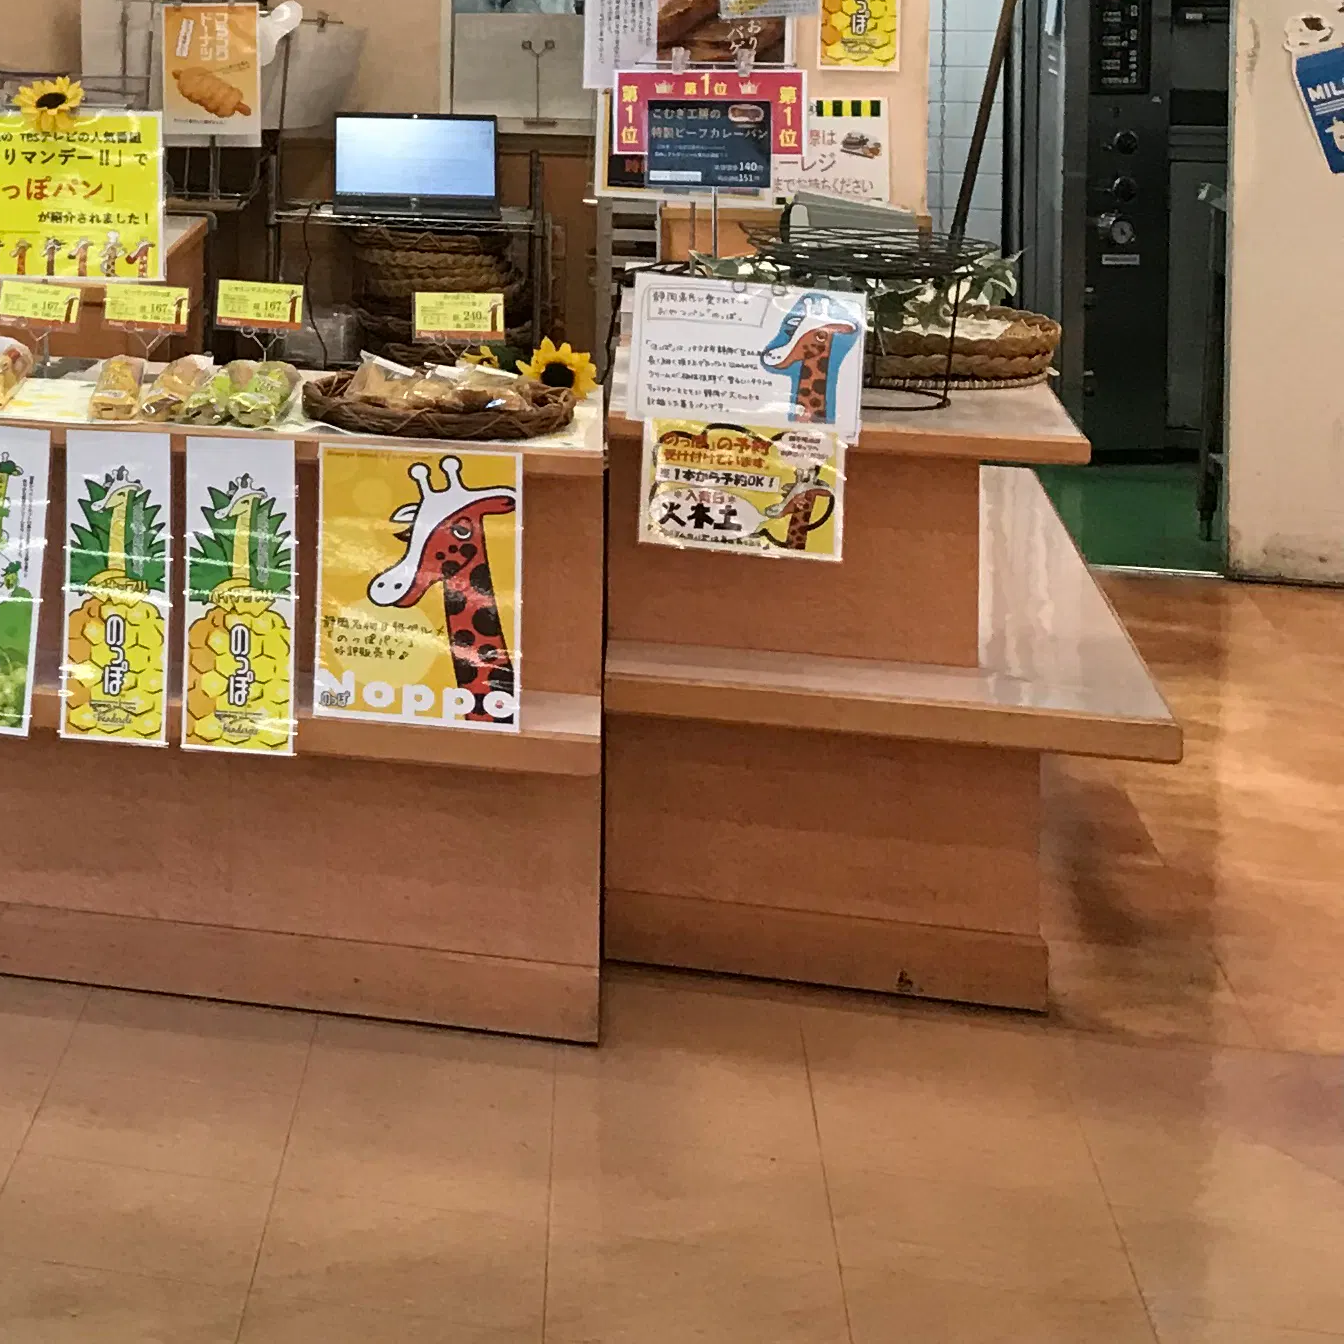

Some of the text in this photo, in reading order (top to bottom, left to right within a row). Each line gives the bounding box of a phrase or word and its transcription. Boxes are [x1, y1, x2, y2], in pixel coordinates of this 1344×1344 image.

[683, 72, 728, 96] 第1位
[1307, 79, 1344, 102] MIL
[621, 84, 639, 145] 第1位
[652, 106, 721, 121] こむぎ工房の
[778, 86, 798, 148] 第1位
[20, 131, 142, 145] TBSテレビの人気番組
[651, 126, 768, 141] 特製ビーフカレーパン
[38, 211, 150, 225] が紹介されました!
[264, 301, 282, 312] 167
[463, 310, 483, 321] 240
[658, 501, 742, 531] 火木土
[102, 613, 130, 696] のっぽ
[227, 622, 255, 707] のっぽ
[314, 667, 521, 720] Noppo
